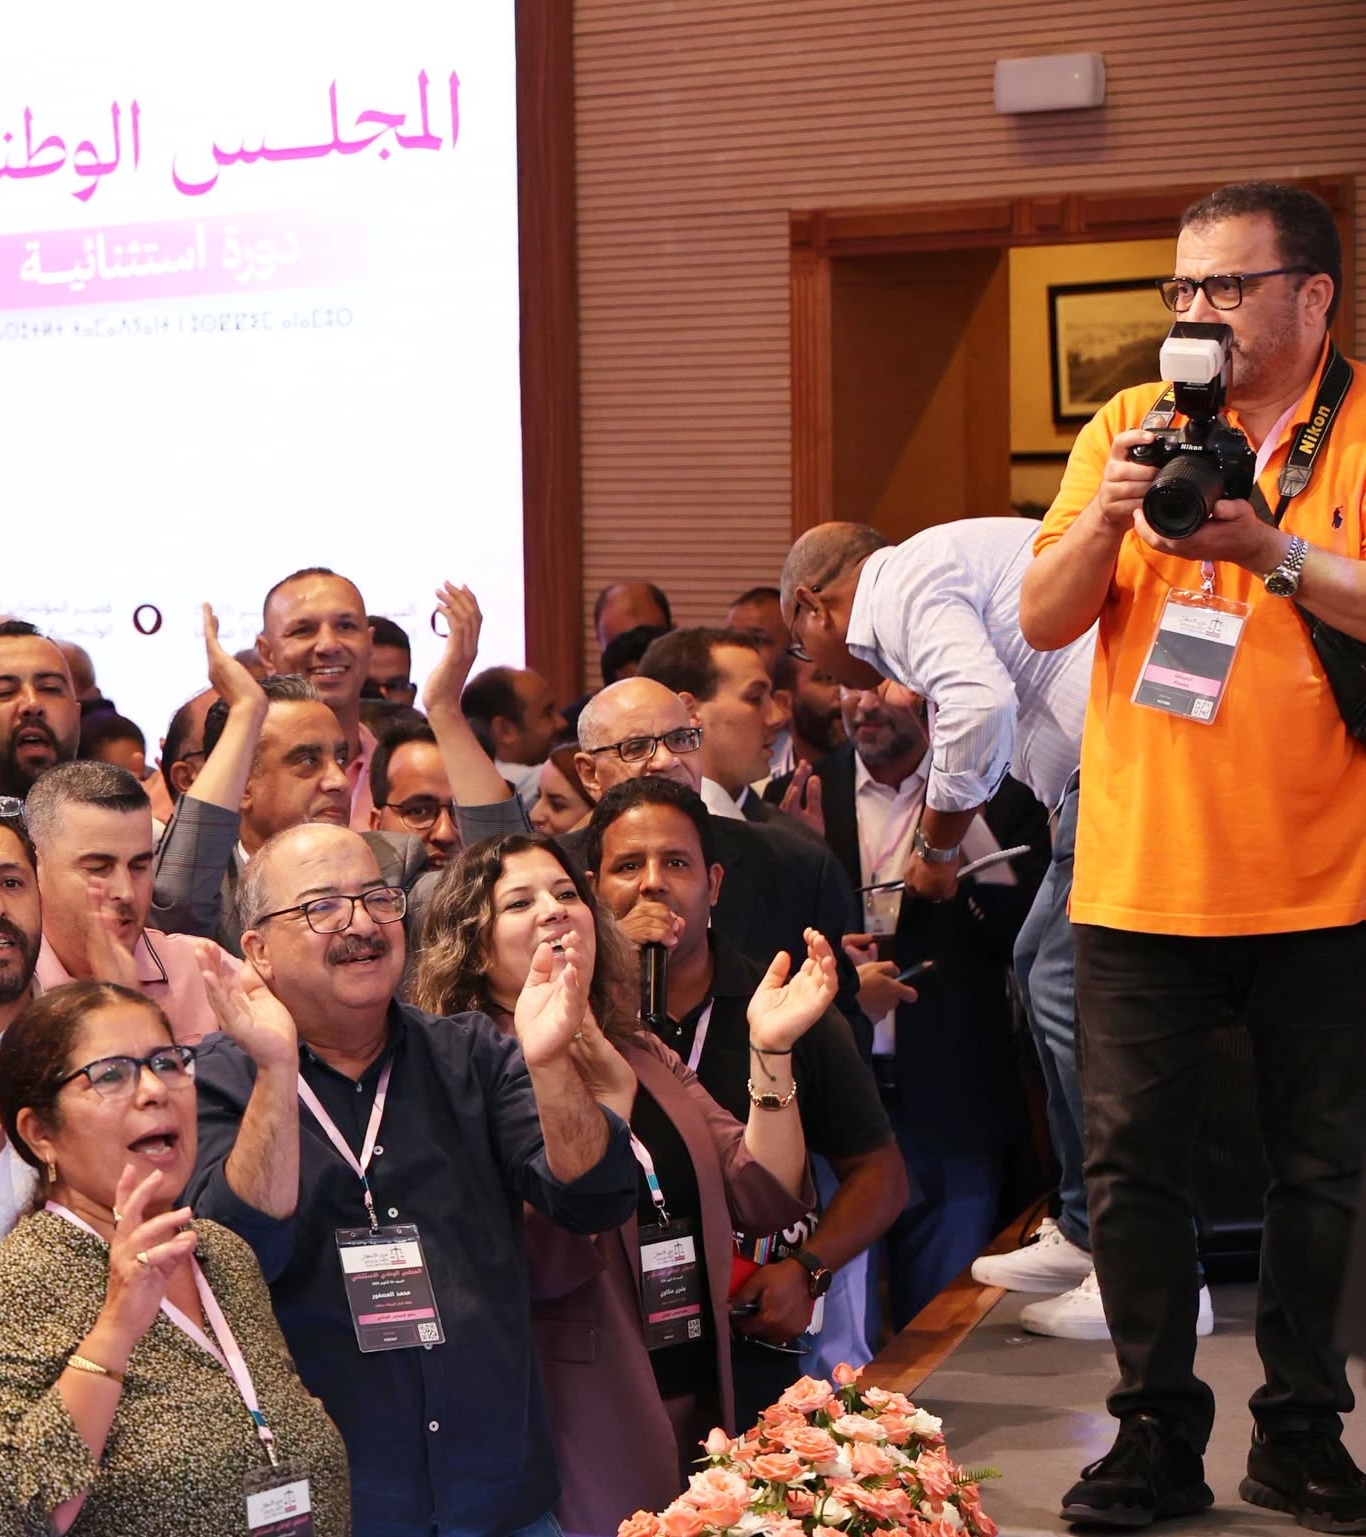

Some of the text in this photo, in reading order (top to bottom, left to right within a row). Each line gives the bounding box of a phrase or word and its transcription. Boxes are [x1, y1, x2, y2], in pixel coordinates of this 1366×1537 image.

[172, 69, 461, 196] المجلس
[1180, 443, 1203, 451] Nikon
[1299, 405, 1331, 455] Nikon
